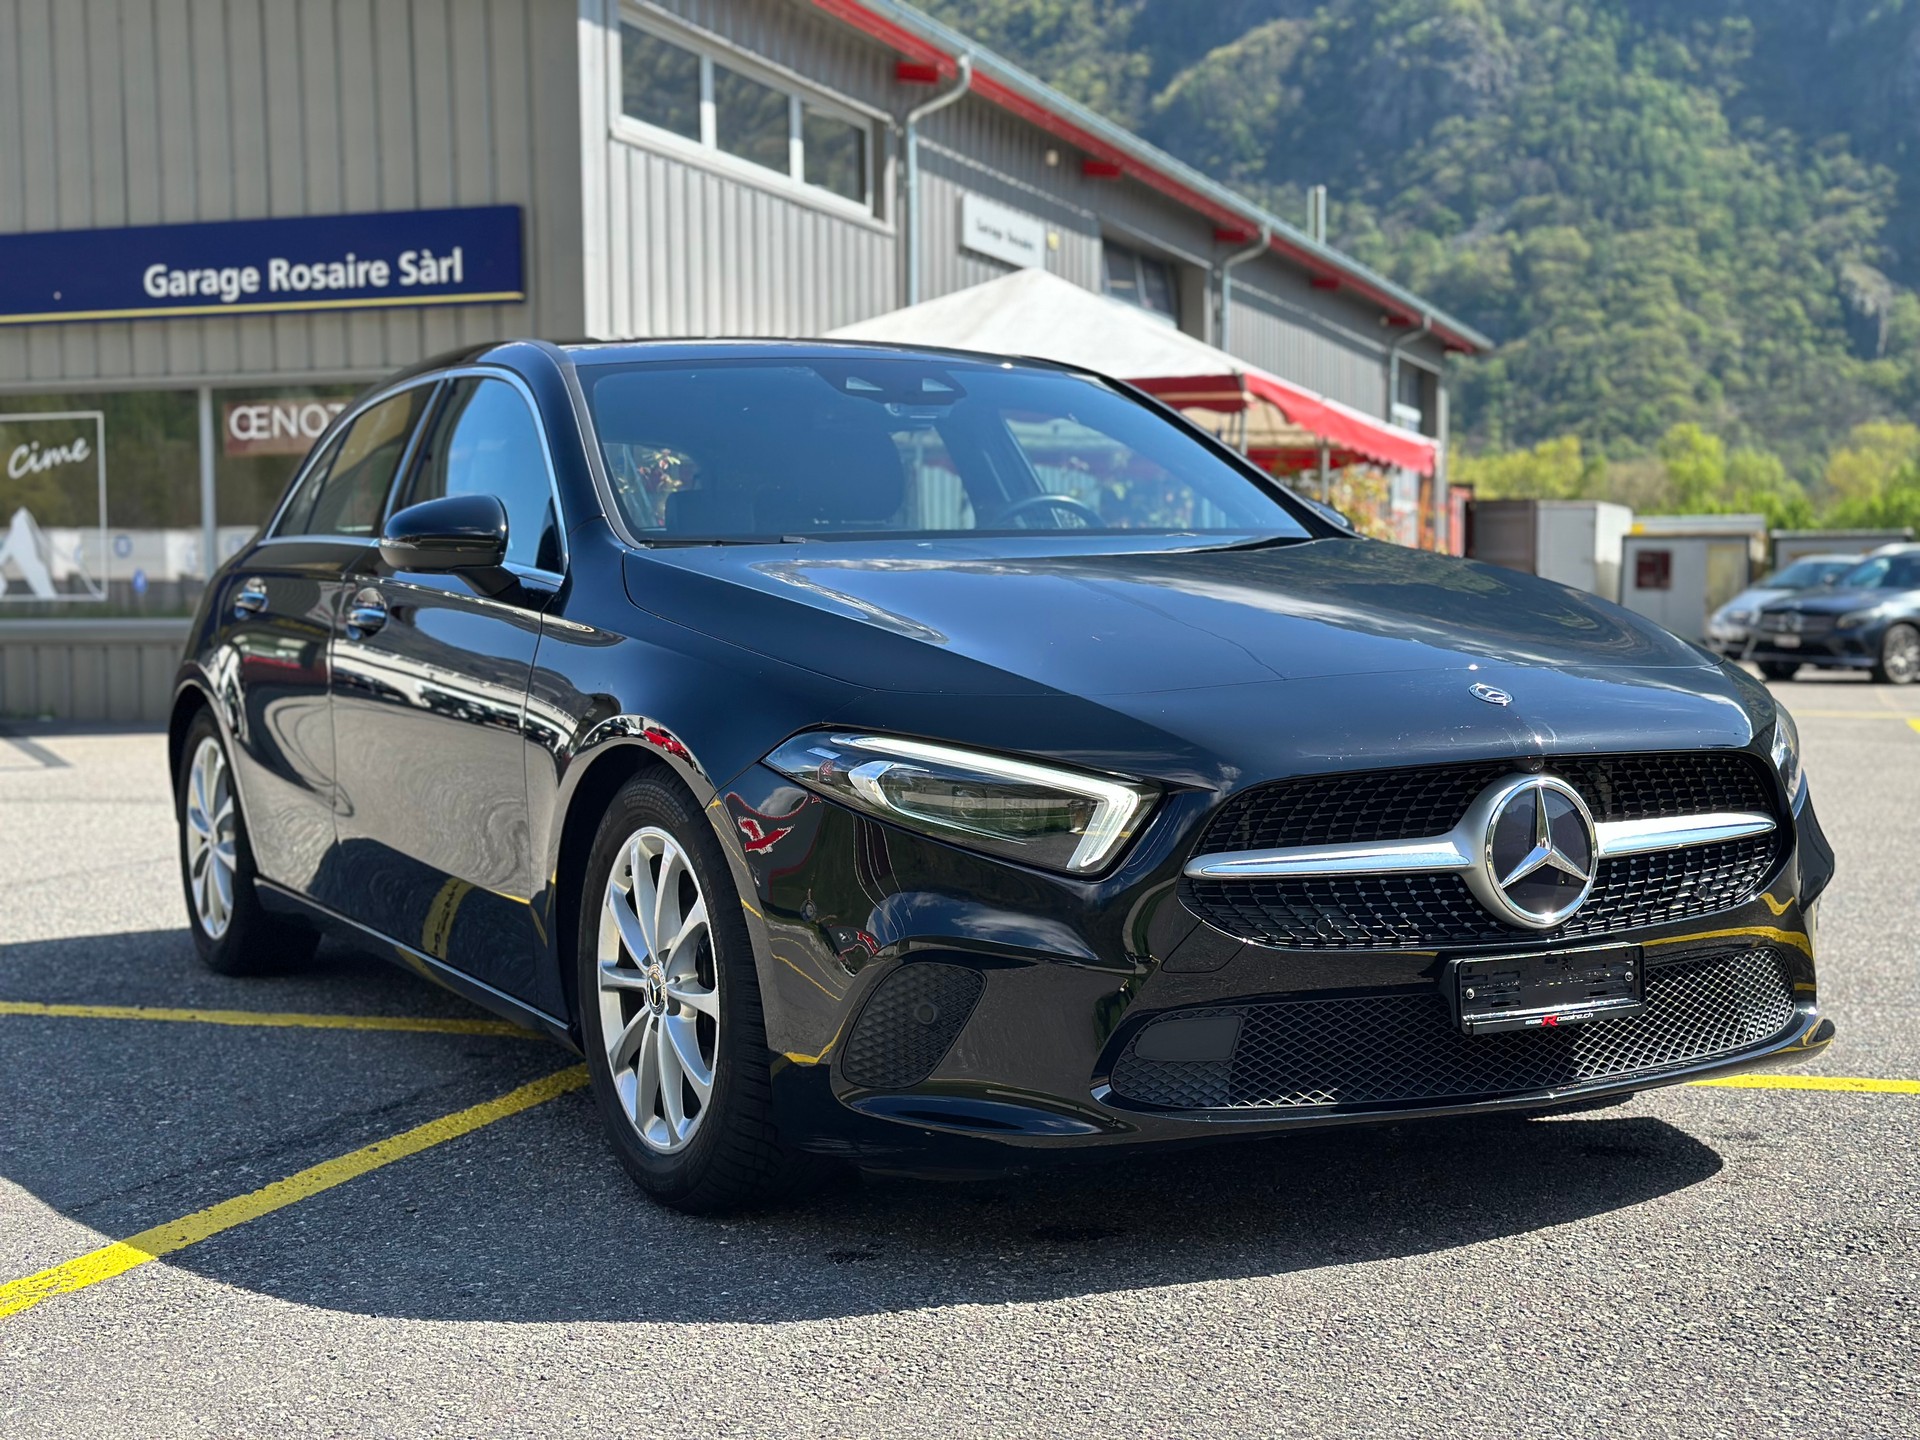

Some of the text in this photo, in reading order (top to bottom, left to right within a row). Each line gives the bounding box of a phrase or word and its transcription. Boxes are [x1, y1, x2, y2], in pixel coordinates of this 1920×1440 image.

[143, 247, 463, 303] Garage Rosaire Sàrl
[7, 437, 91, 480] Cime
